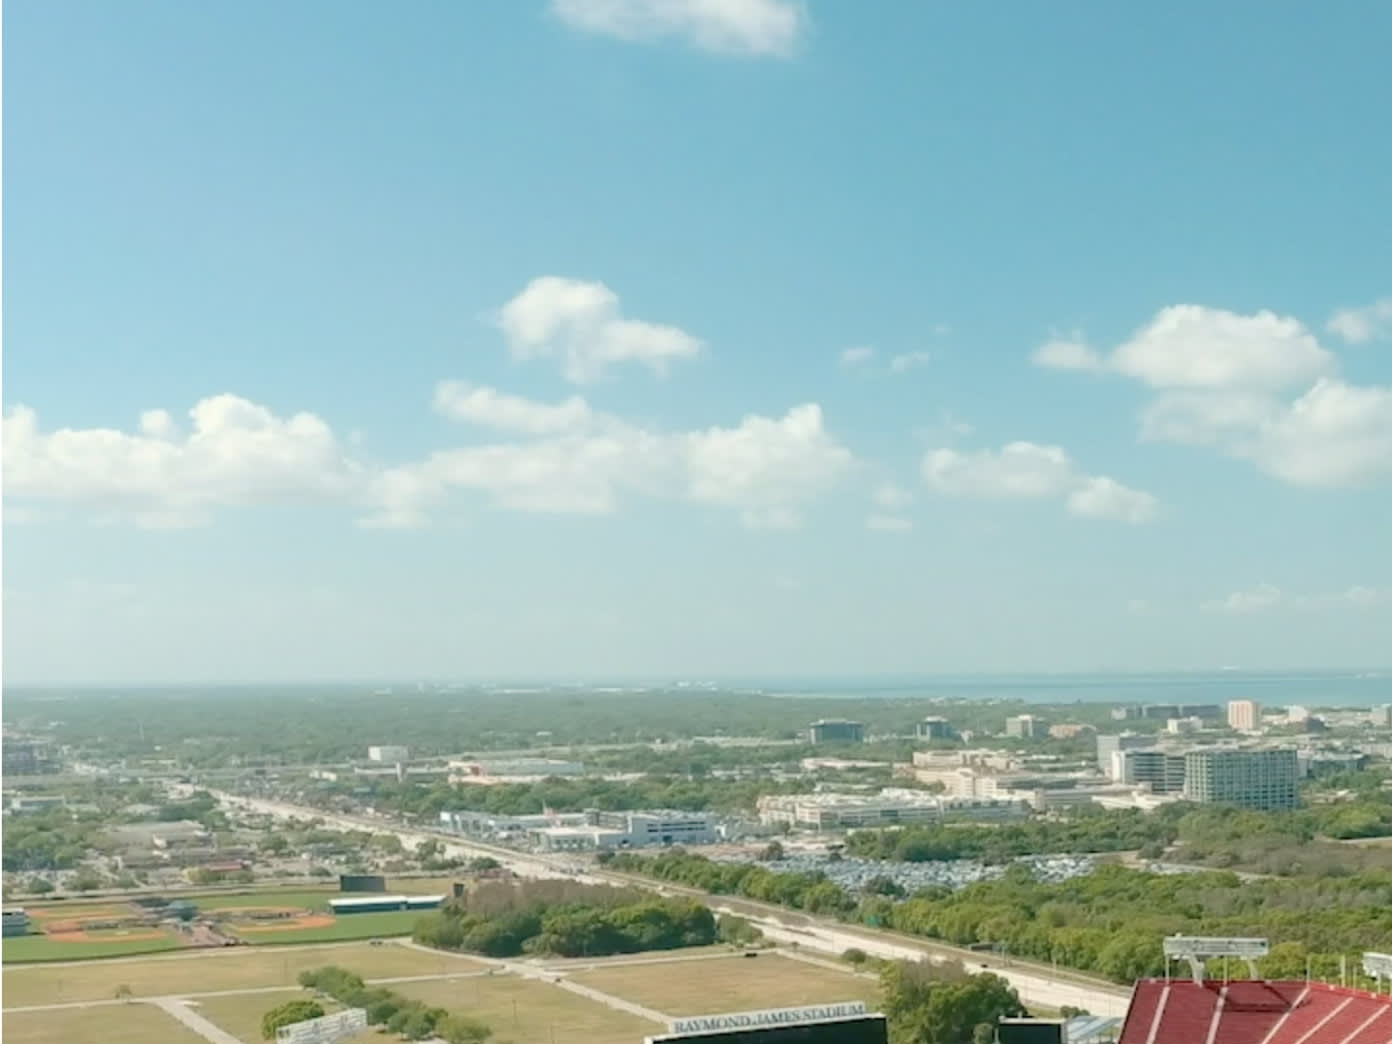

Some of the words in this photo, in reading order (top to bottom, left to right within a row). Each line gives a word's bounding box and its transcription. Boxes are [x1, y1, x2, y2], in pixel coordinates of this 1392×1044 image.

[674, 1015, 751, 1033] RAYMOND
[752, 1010, 800, 1027] JAMES
[802, 1003, 865, 1021] STADIUM
